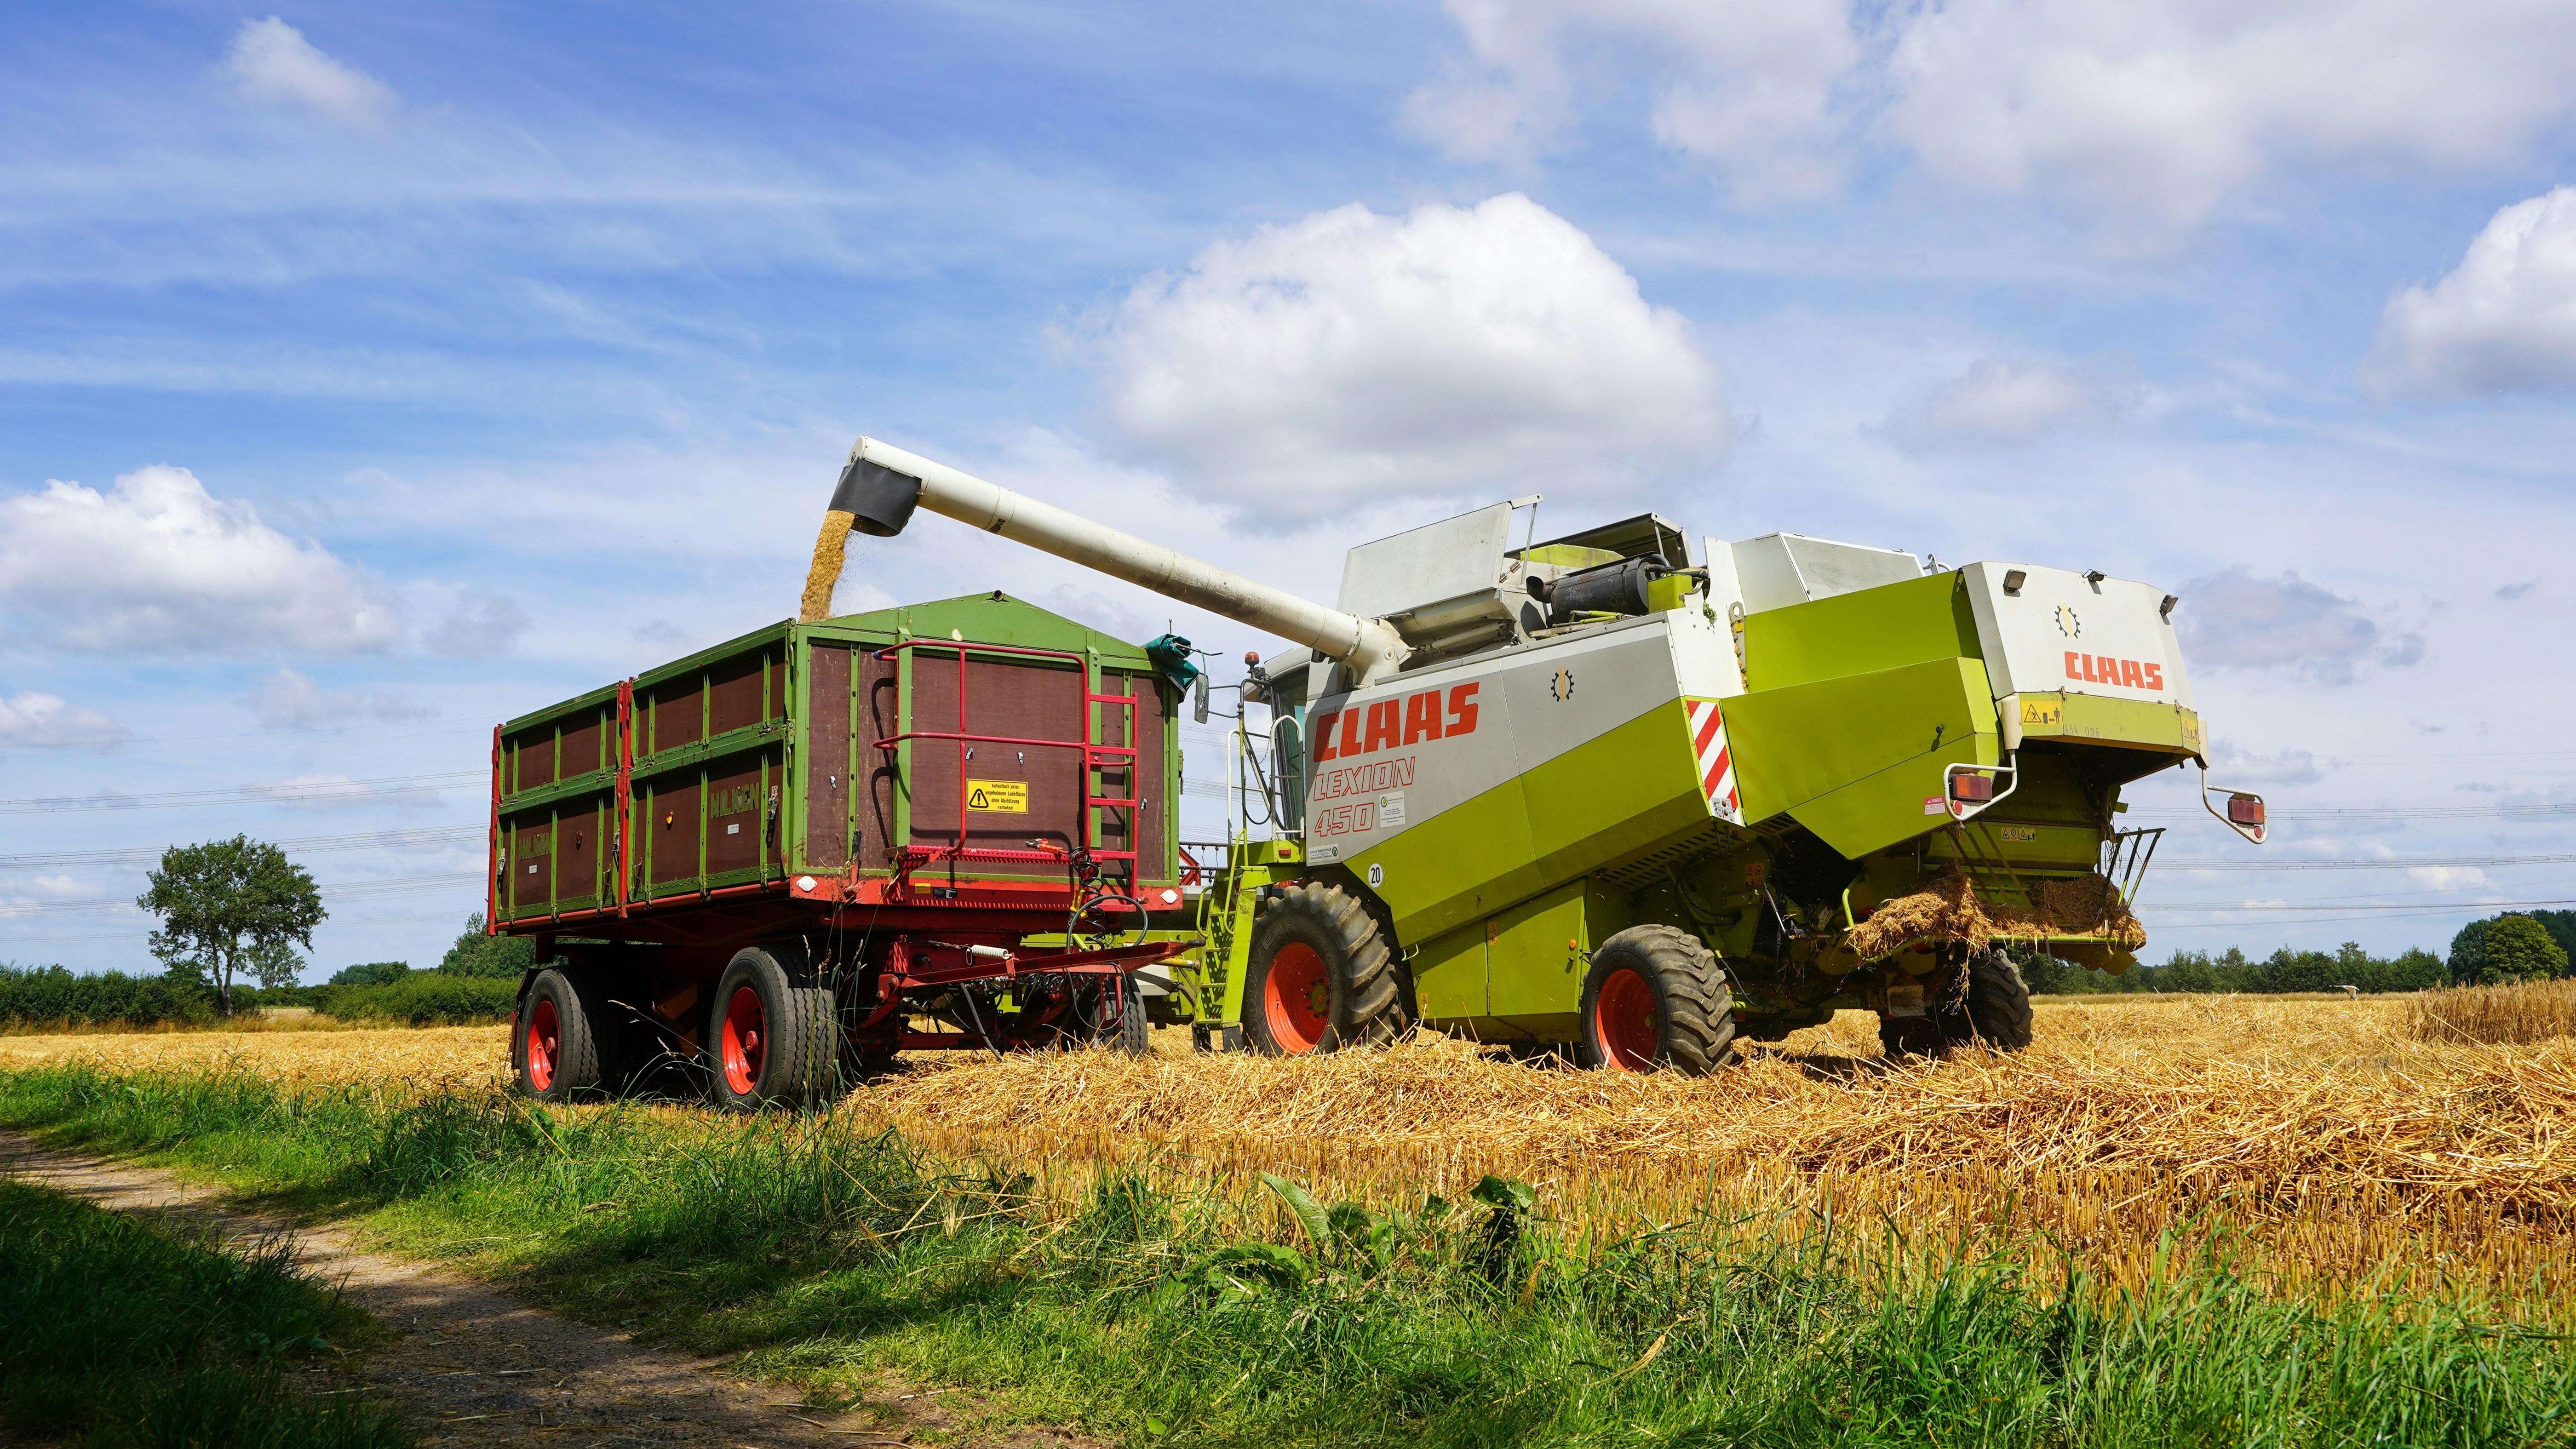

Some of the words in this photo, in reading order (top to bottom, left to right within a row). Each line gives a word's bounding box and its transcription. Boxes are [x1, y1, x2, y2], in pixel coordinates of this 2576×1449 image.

[2064, 651, 2163, 691] CLAAS
[1313, 682, 1480, 763] CLAAS
[1313, 756, 1416, 801] LEXION
[1314, 802, 1375, 837] 450
[1371, 866, 1380, 883] 20
